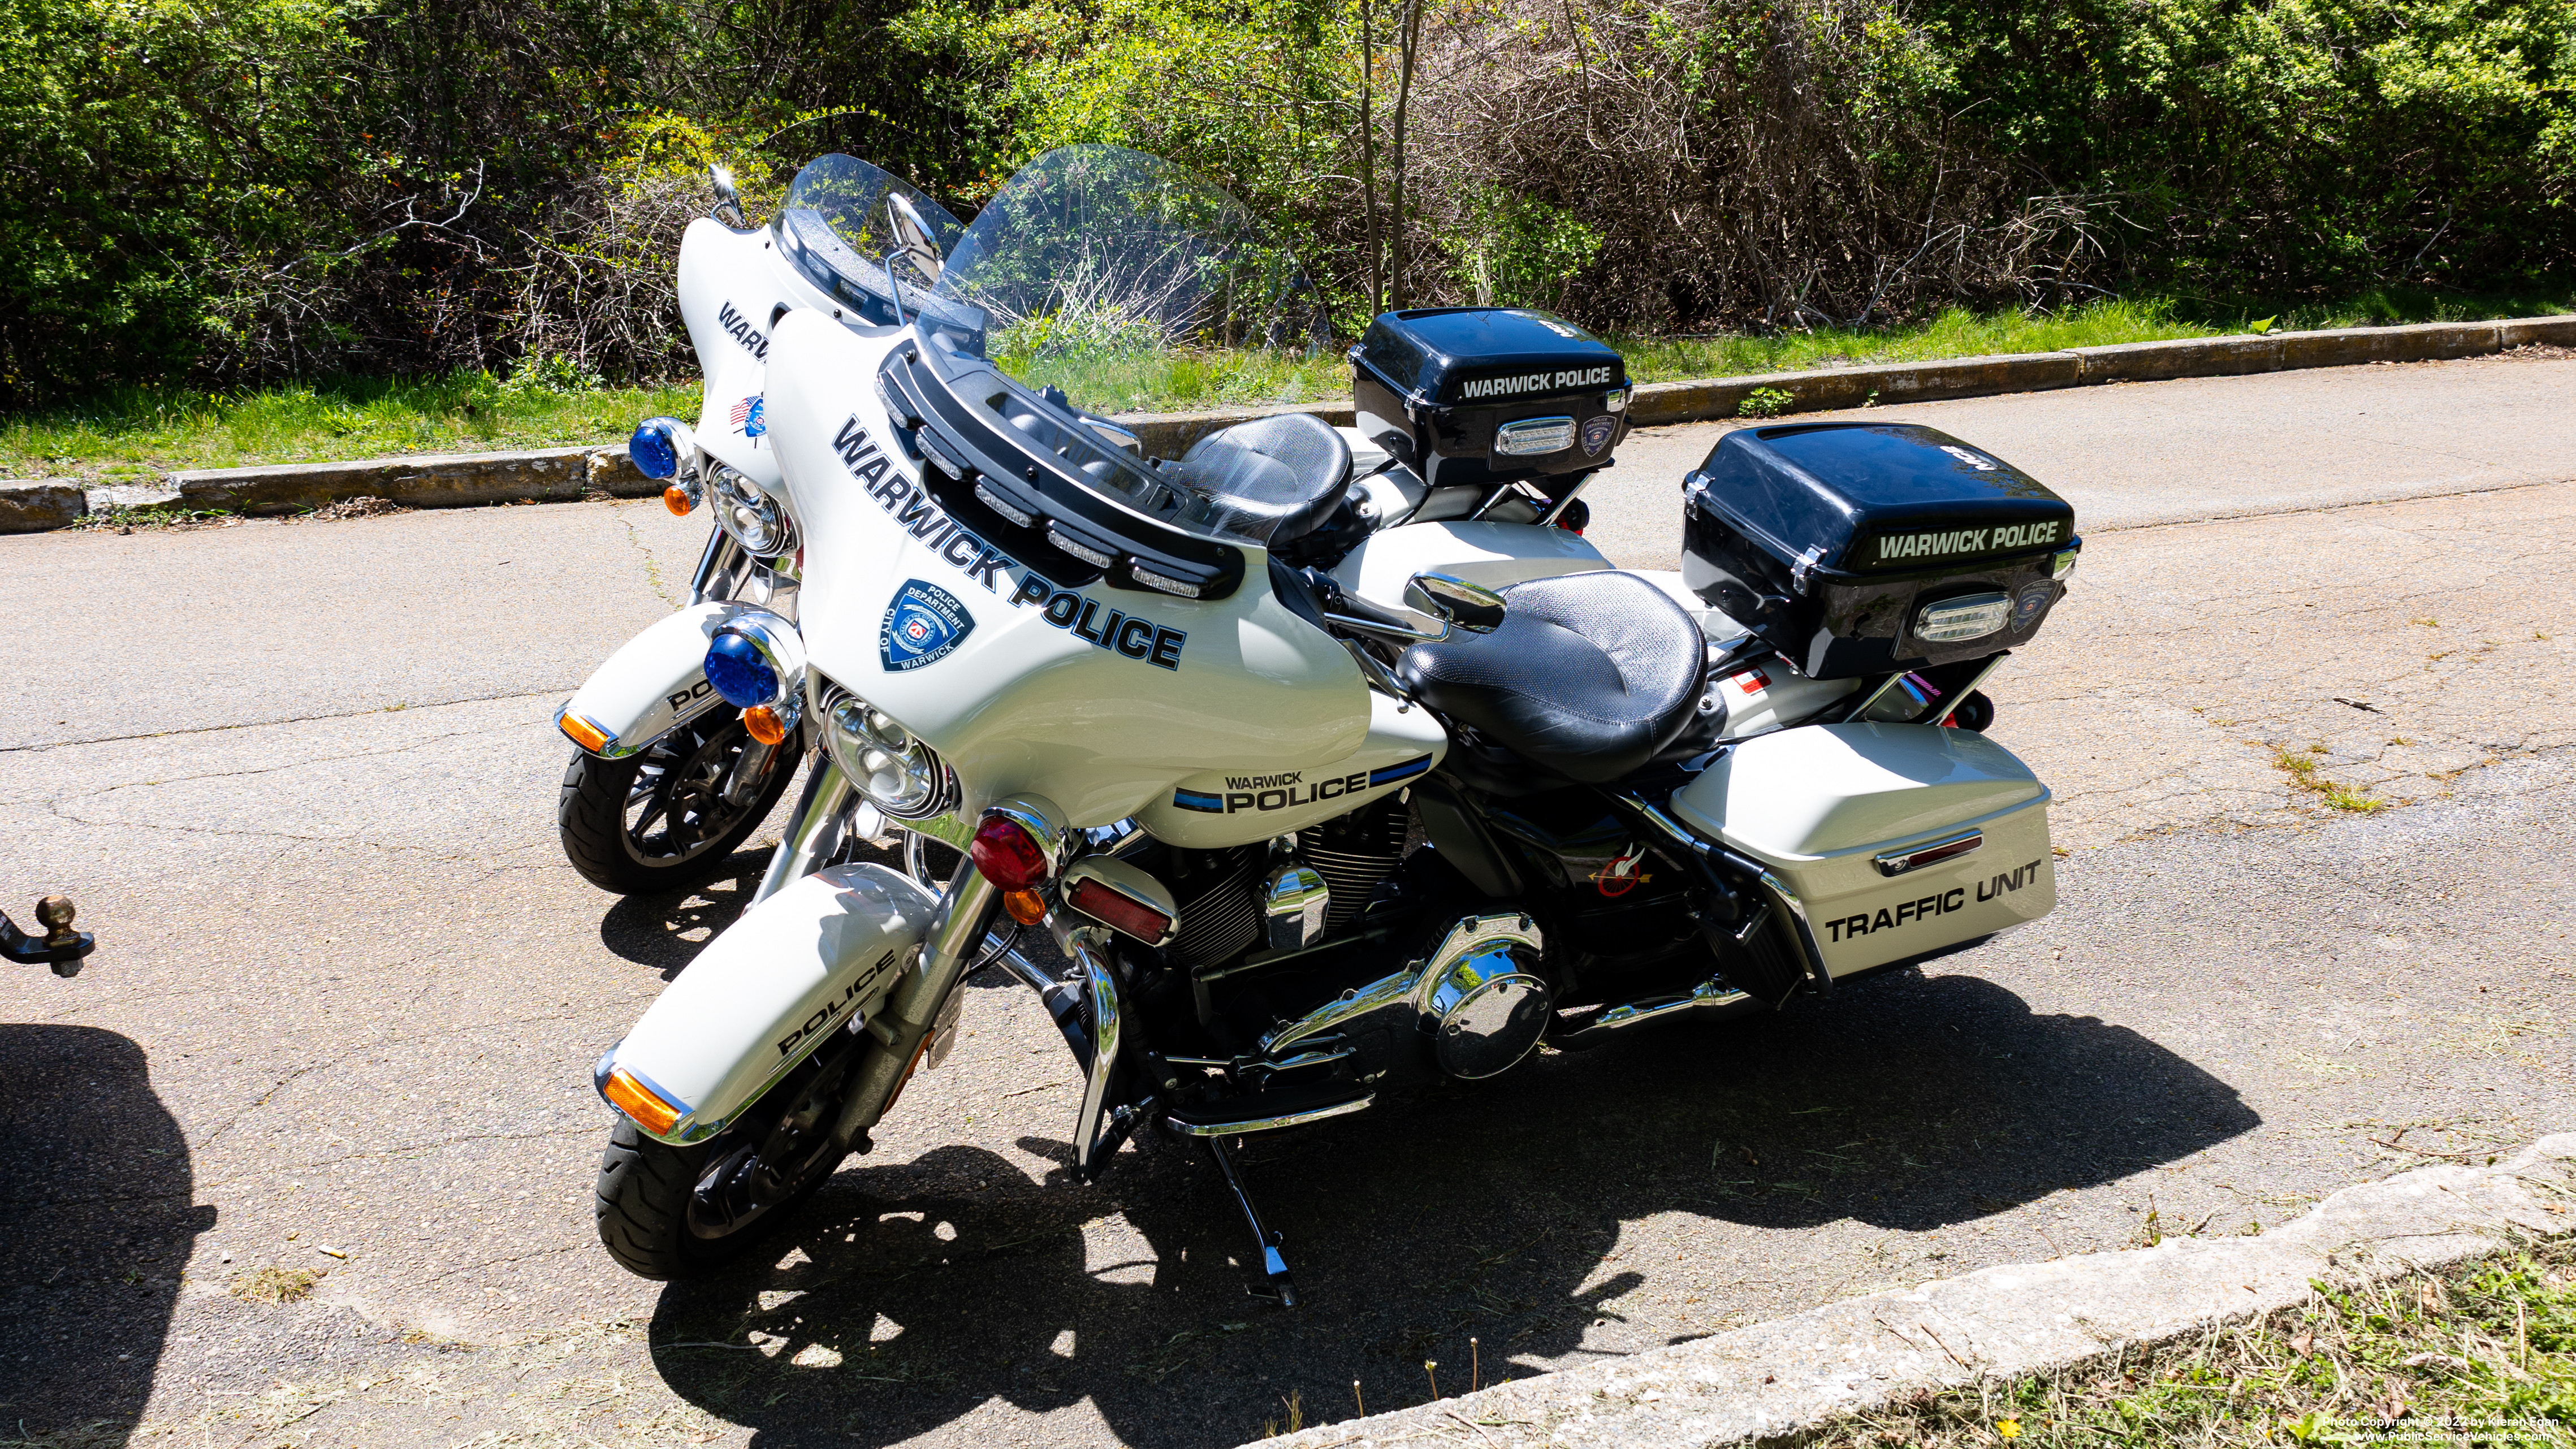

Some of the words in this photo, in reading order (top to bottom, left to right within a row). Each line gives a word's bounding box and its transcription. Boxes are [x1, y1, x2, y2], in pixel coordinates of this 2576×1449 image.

[1463, 373, 1551, 398] WARWICK
[1555, 367, 1610, 388] POLICE
[1939, 445, 1995, 470] MC8
[832, 413, 1020, 594] WARWICK
[1008, 565, 1187, 672] POLICE
[1881, 529, 1989, 559] WARWICK
[1991, 521, 2059, 550] POLICE
[907, 587, 965, 629] DEPARTMENT
[928, 586, 961, 612] POLICE
[881, 608, 895, 634] CITY
[880, 637, 889, 652] OF
[901, 642, 954, 670] WARWICK
[1225, 771, 1303, 790] WARWICK
[1225, 771, 1367, 814] POLICE
[1825, 888, 1964, 942] TRAFFIC
[1977, 859, 2041, 902] UNIT
[777, 949, 896, 1057] POLICE
